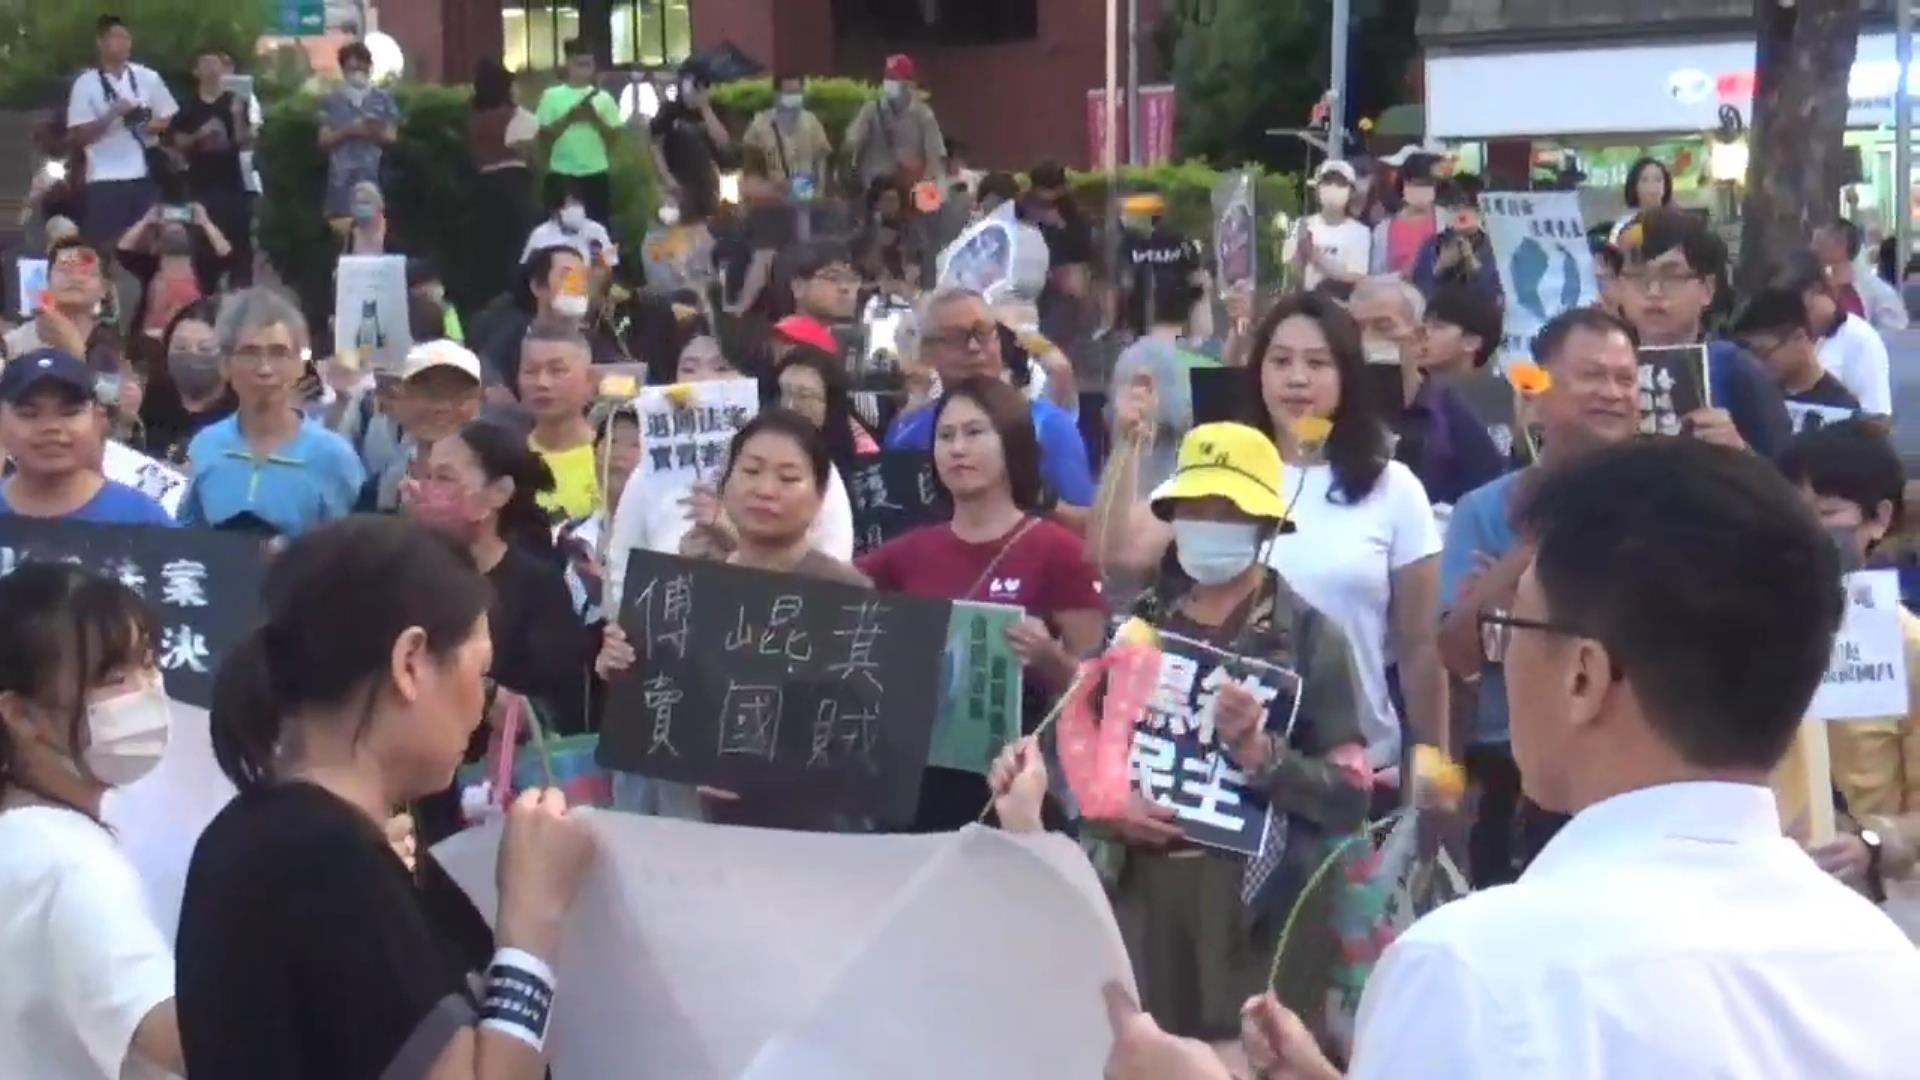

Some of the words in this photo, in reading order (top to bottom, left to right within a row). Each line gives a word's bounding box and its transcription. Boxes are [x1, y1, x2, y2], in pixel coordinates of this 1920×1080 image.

[643, 671, 882, 774] 賣國賊
[1129, 731, 1246, 832] 民主
